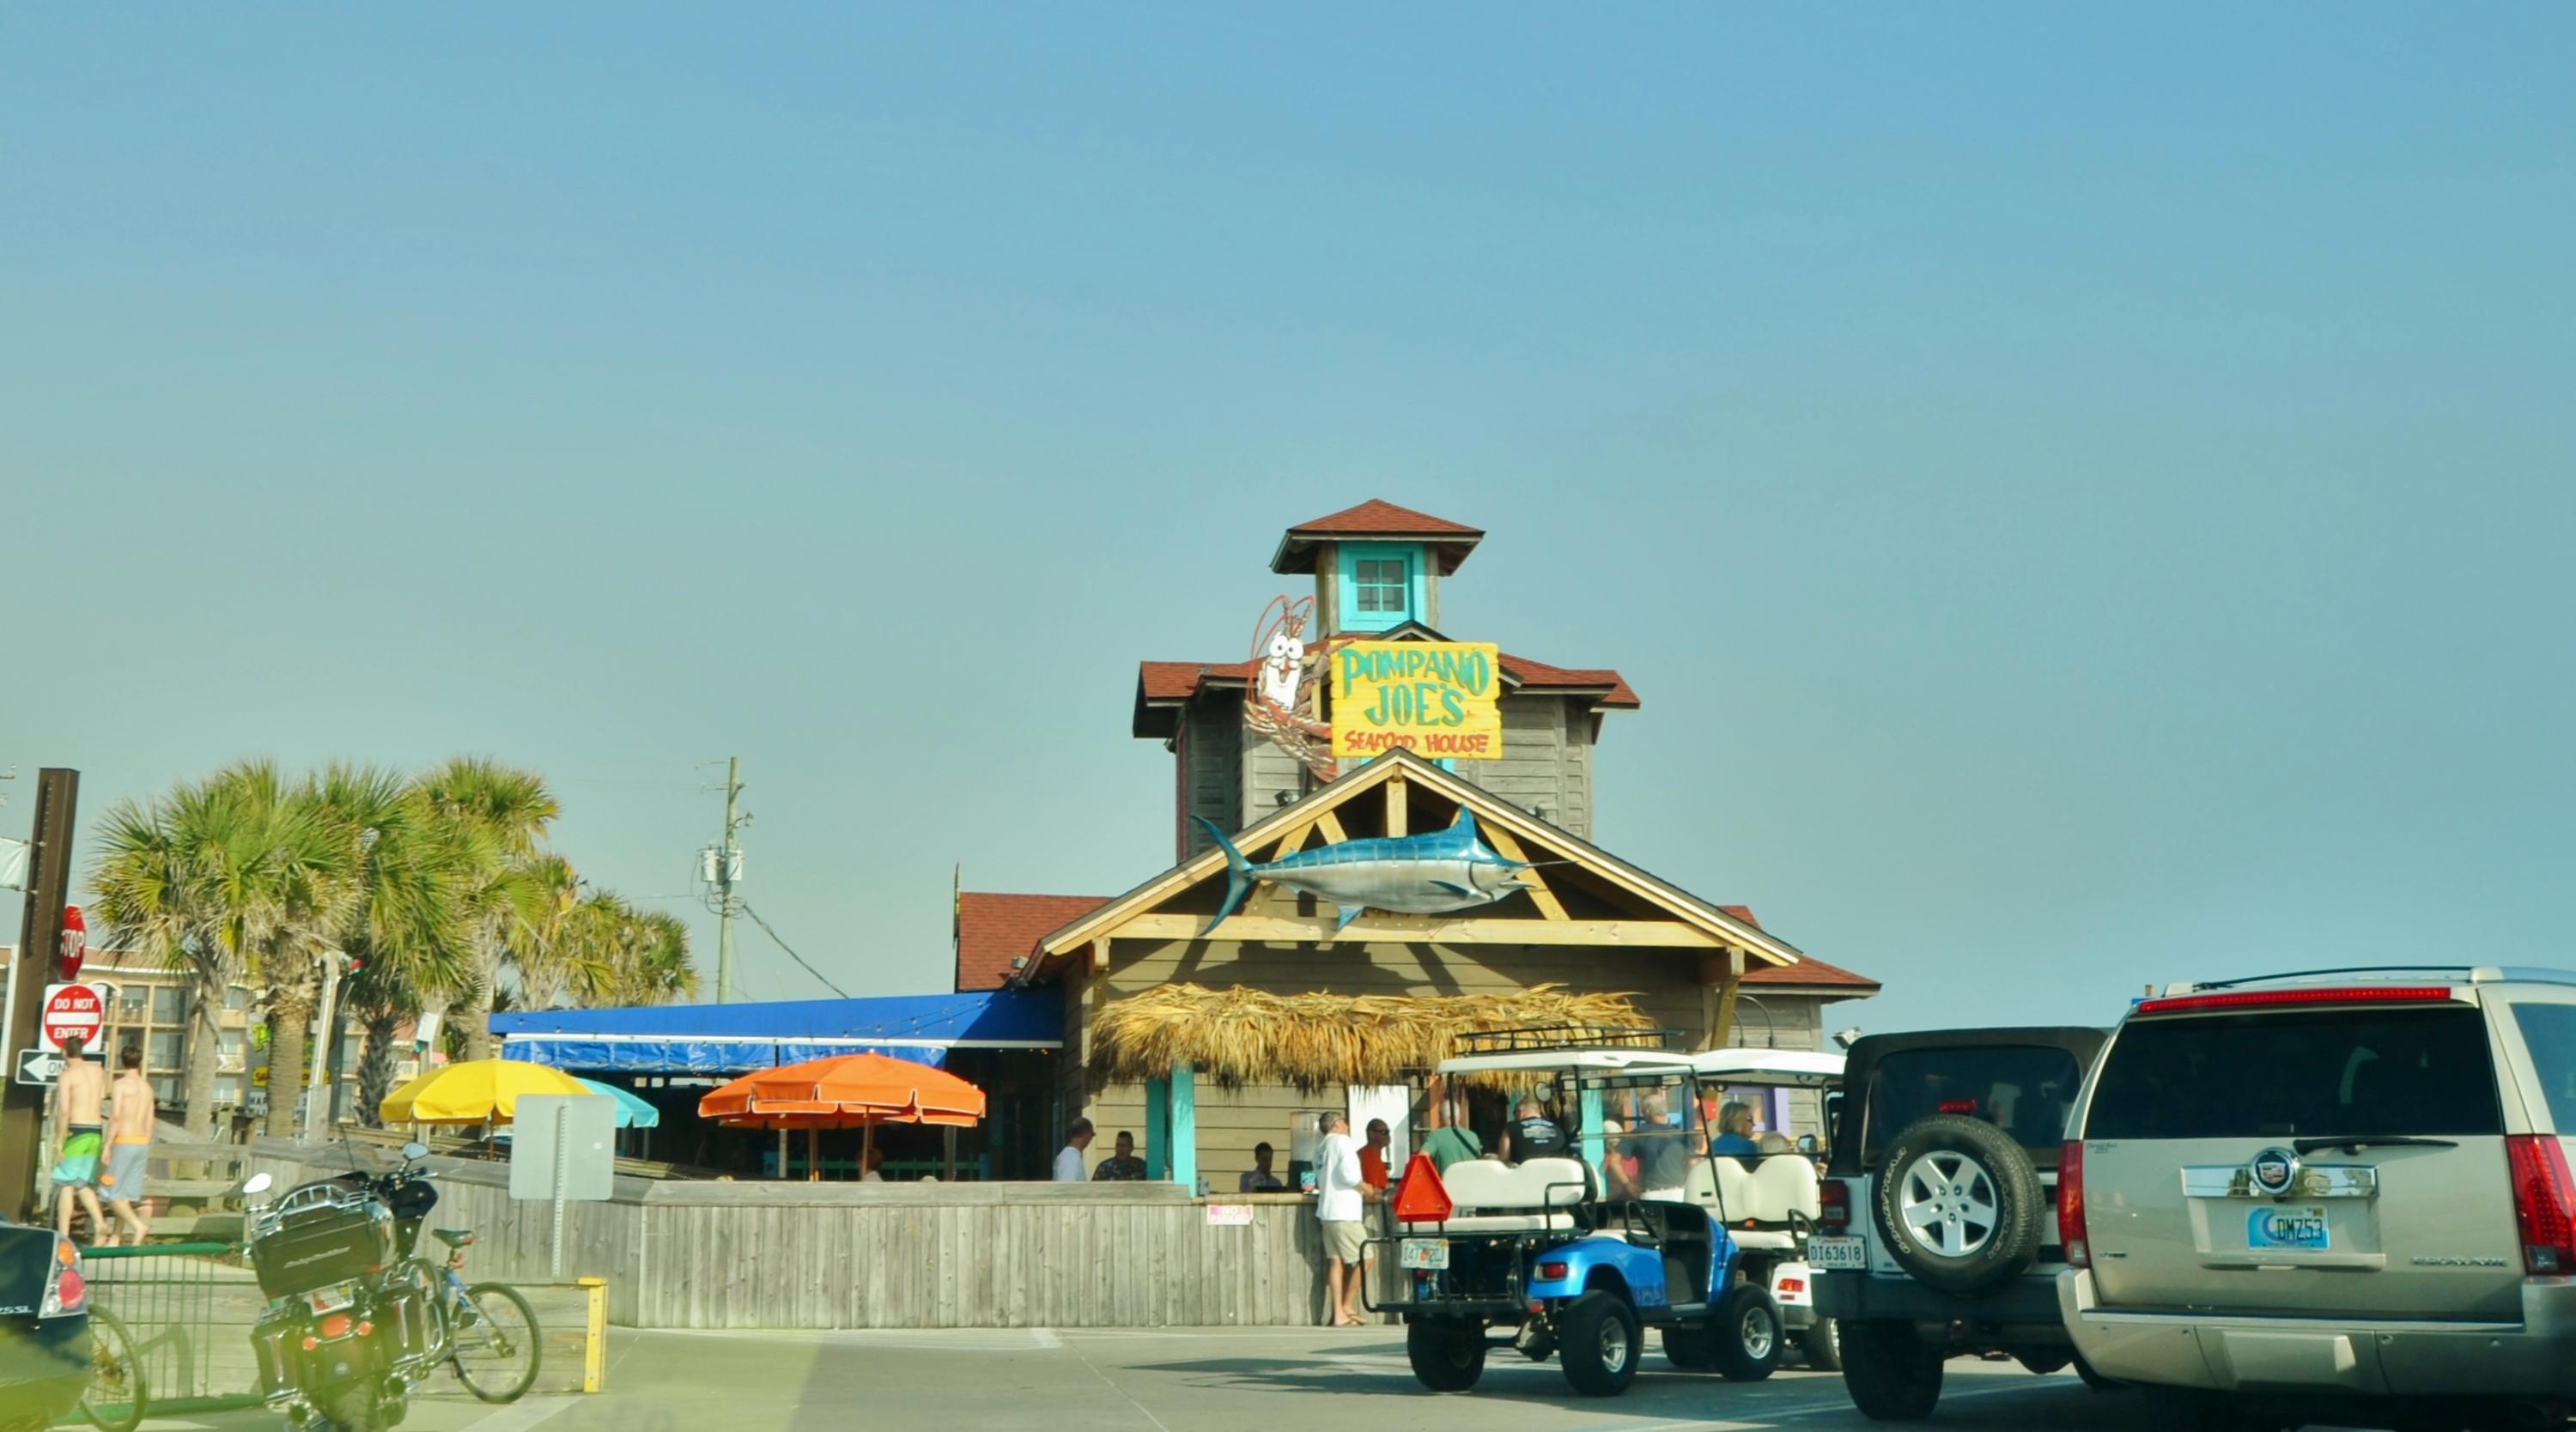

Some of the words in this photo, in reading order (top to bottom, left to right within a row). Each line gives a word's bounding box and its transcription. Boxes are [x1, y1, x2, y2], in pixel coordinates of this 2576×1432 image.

[1339, 648, 1490, 699] POMPANO
[1364, 682, 1465, 726] JOE'S
[1425, 734, 1490, 753] HOUSE
[54, 998, 70, 1010] DO
[73, 998, 95, 1010] NOT
[54, 1027, 88, 1040] ENTER
[48, 1061, 67, 1074] ON
[2276, 1218, 2323, 1240] DMZ53
[1809, 1246, 1862, 1261] DI63618
